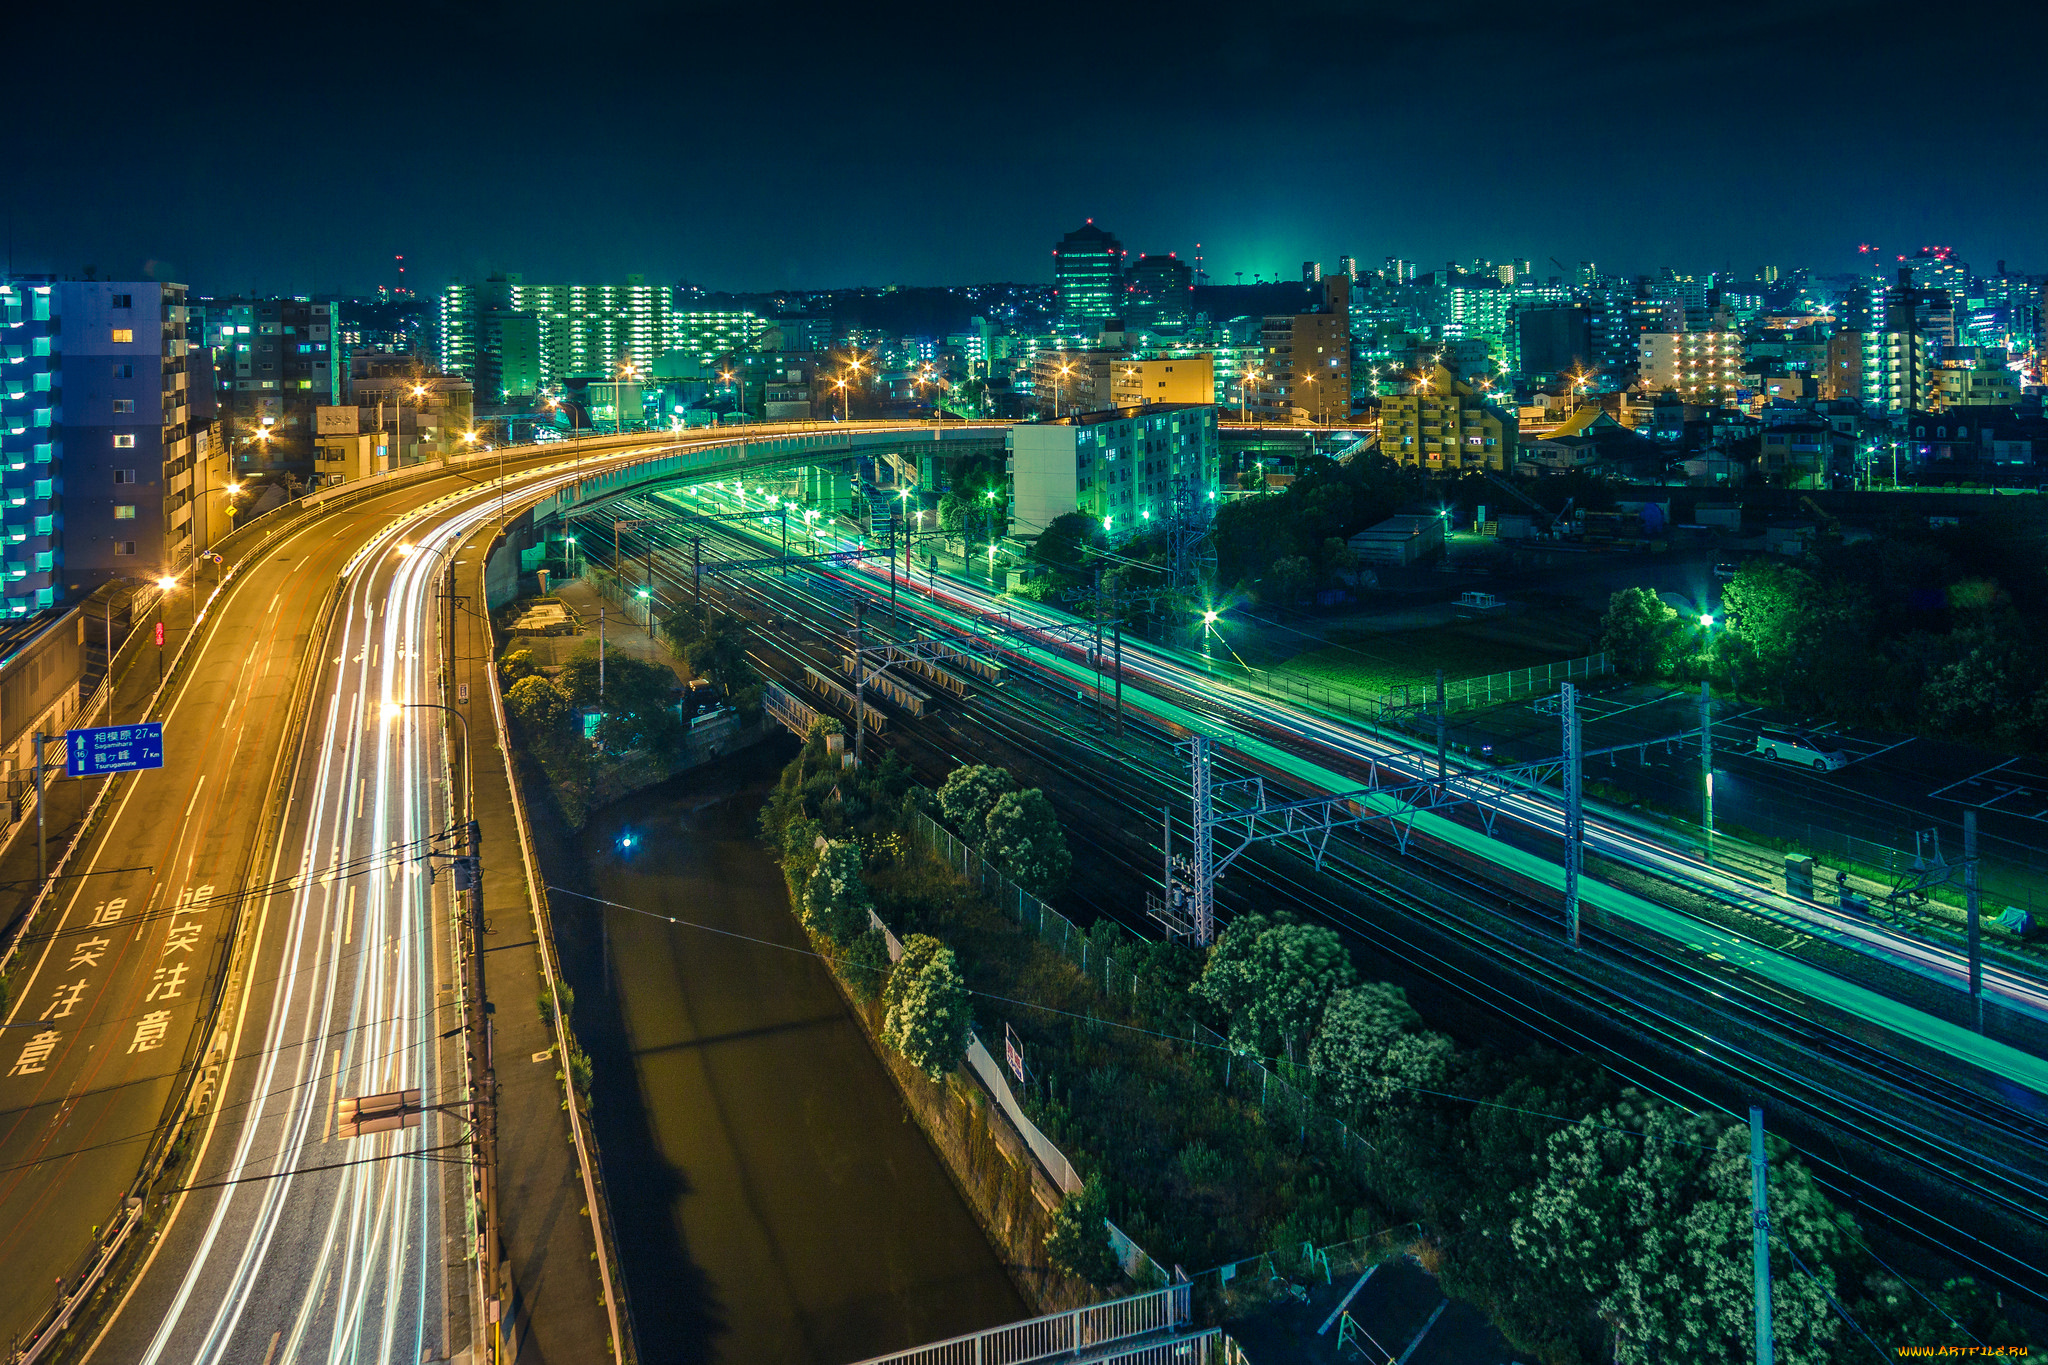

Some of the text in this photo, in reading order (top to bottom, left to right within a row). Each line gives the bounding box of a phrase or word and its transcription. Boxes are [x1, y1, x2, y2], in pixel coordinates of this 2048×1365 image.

[94, 730, 132, 743] 相模原
[135, 728, 149, 740] 27
[94, 741, 133, 750] Sagamihara
[142, 748, 149, 759] 7
[95, 761, 137, 769] Tsurugamine
[126, 884, 215, 1055] 追突注意
[6, 897, 128, 1078] 追突注意
